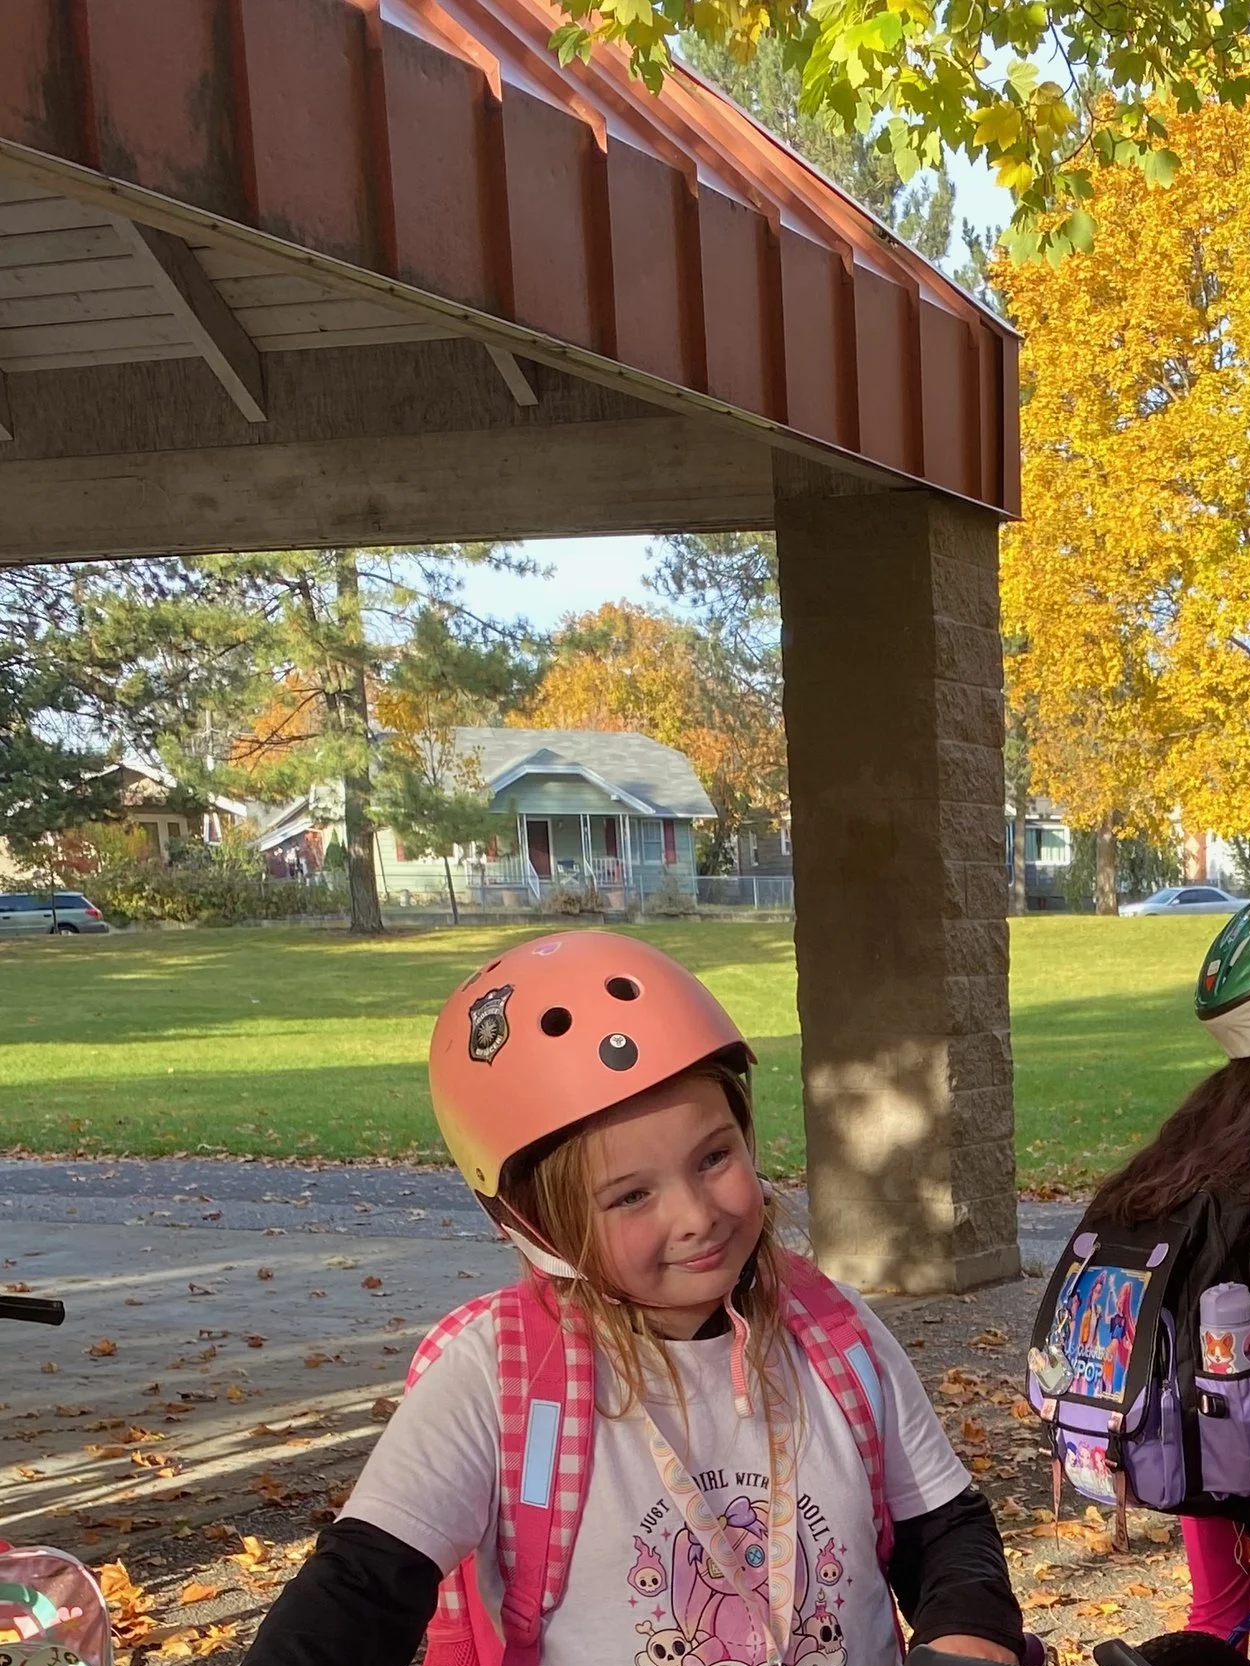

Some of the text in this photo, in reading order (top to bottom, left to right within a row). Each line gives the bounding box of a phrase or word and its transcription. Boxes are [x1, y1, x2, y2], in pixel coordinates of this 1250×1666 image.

[639, 1469, 829, 1542] JUST IRL WITH DOLL
